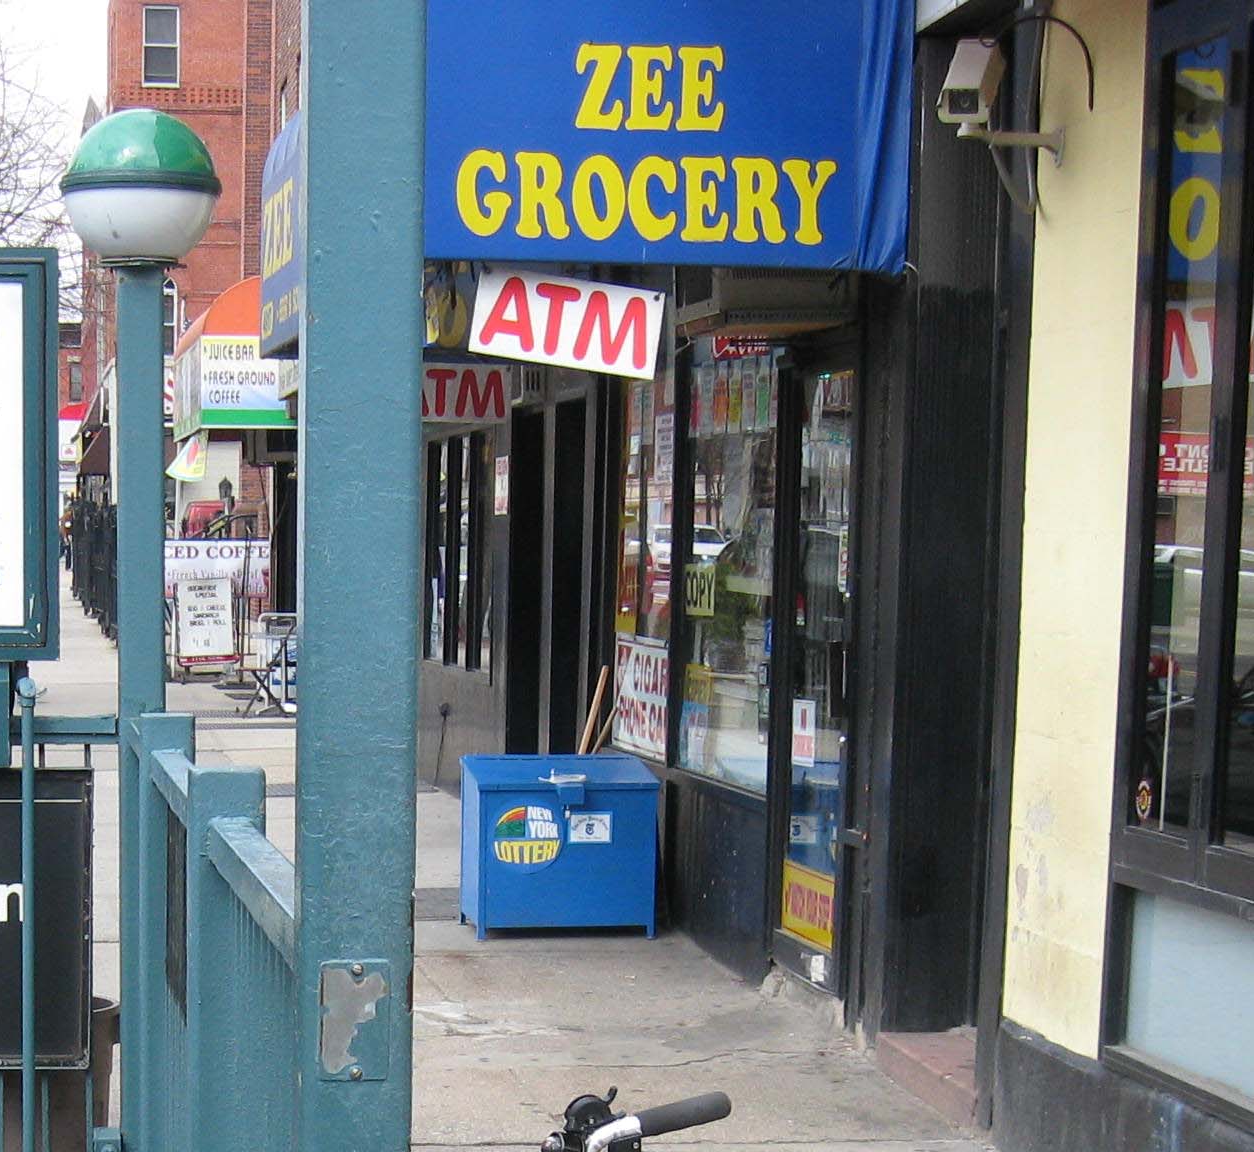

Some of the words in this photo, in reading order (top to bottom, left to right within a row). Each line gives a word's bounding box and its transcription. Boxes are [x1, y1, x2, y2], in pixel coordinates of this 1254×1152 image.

[575, 42, 725, 132] ZEE
[456, 149, 838, 246] GROCERY
[263, 175, 293, 282] ZEE
[479, 276, 647, 370] ATM
[209, 344, 233, 361] JUICE
[236, 344, 254, 361] BAR
[208, 371, 235, 385] FRESH
[237, 371, 276, 386] GROUND
[209, 390, 240, 404] COFFEE
[685, 570, 715, 611] COPY
[648, 704, 668, 744] CA
[527, 805, 553, 822] NEW
[528, 820, 559, 839] YORK
[494, 839, 561, 865] LOTTERY
